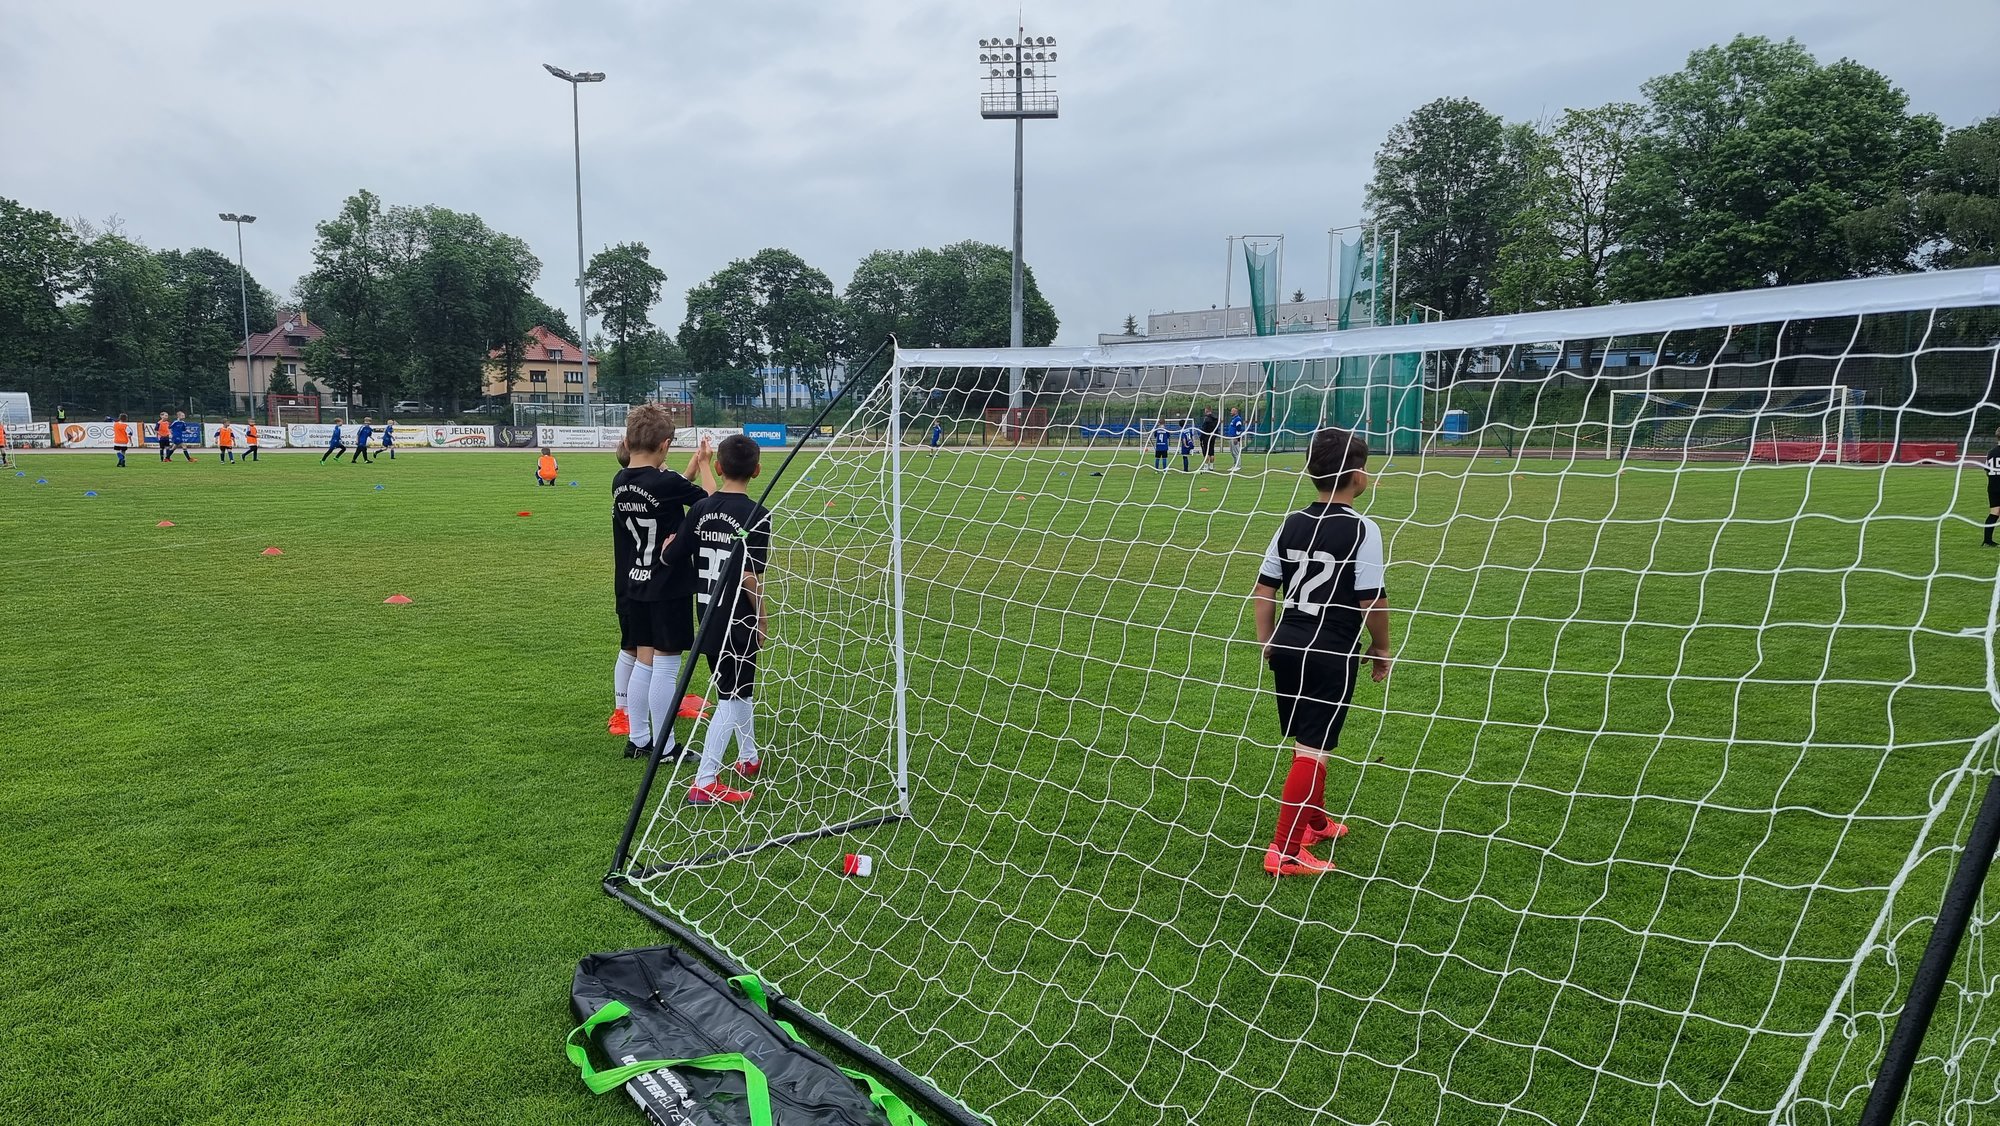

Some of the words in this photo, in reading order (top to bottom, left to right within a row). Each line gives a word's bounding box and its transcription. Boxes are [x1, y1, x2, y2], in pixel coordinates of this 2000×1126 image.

[450, 427, 486, 435] JELENIA
[541, 428, 555, 440] 33
[617, 502, 648, 513] CHOJNIK
[694, 512, 719, 536] AKADEMIA
[718, 512, 743, 535] PIŁKARS
[625, 515, 658, 567] 17
